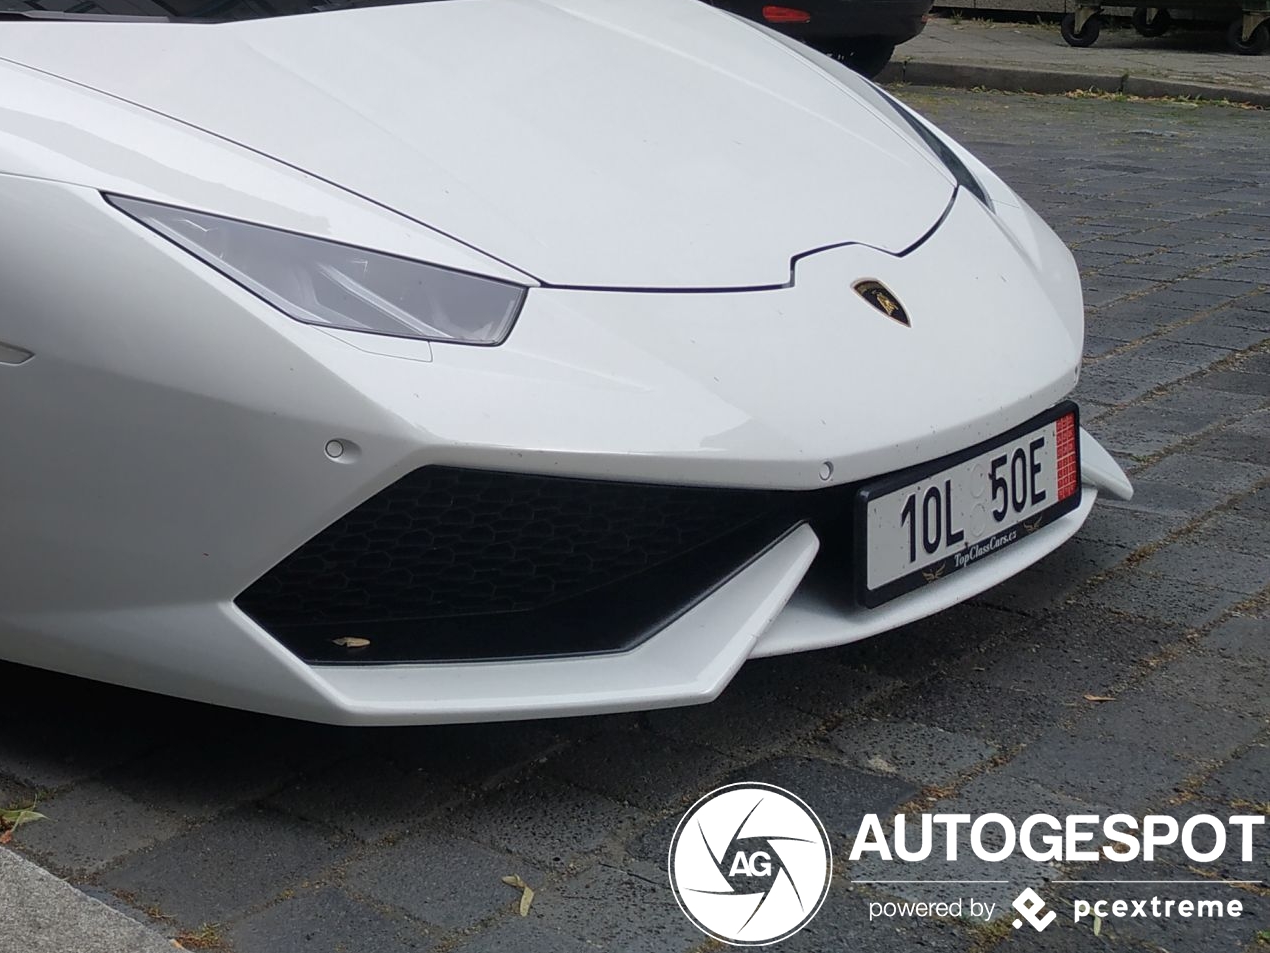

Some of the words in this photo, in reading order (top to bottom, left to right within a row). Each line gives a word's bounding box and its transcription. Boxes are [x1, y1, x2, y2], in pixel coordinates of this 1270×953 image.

[901, 479, 965, 564] 10L
[990, 436, 1047, 523] 50E
[953, 530, 1018, 567] TopClassCars.cz
